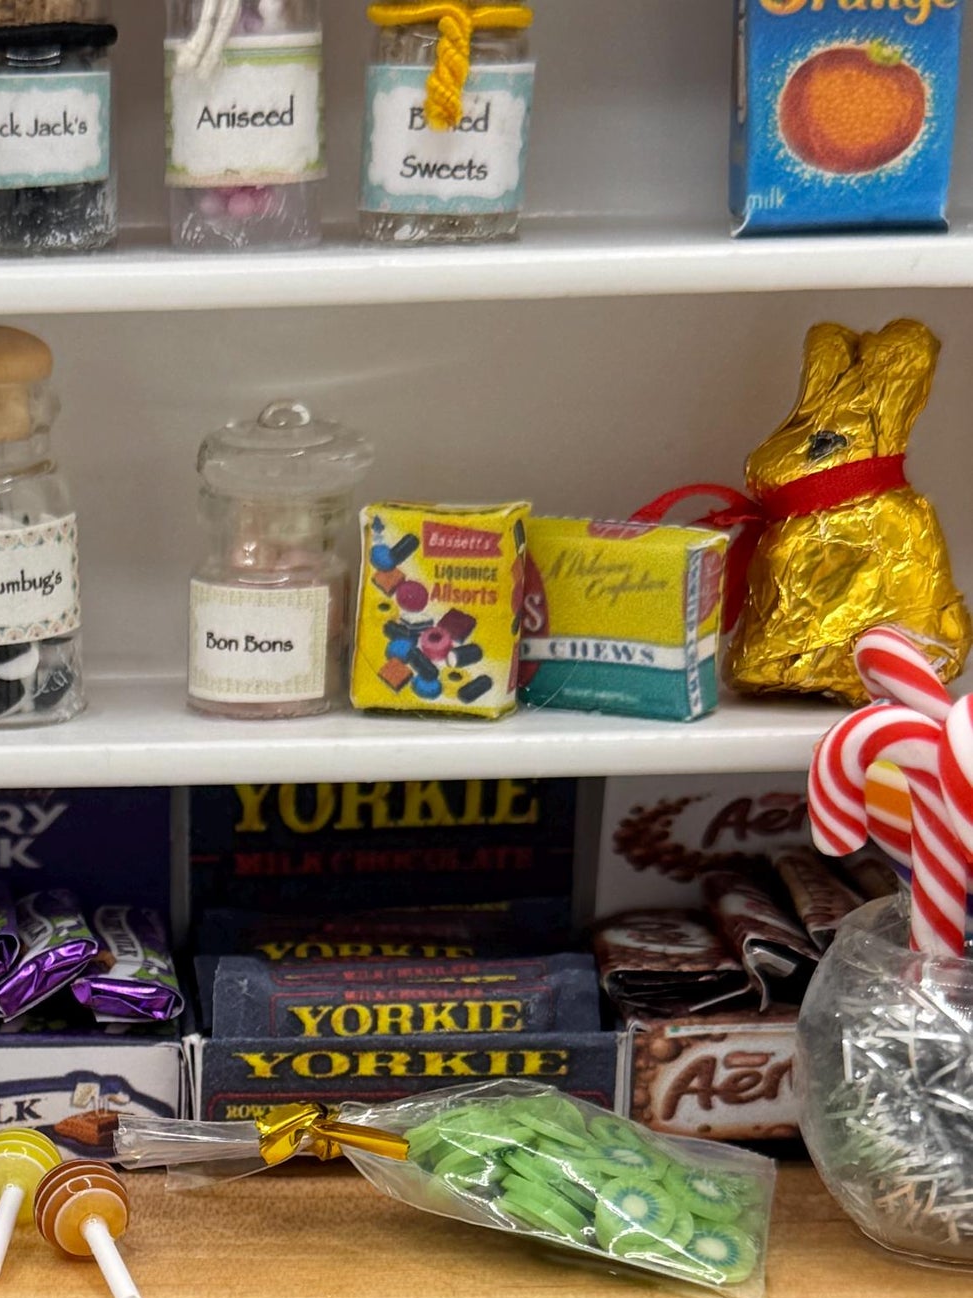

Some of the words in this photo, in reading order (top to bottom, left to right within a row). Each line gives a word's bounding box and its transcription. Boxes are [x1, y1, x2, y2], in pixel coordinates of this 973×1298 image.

[25, 109, 88, 138] Jack's
[197, 96, 294, 130] Aniseed
[408, 101, 491, 133] Bed
[399, 154, 489, 181] Sweets
[430, 582, 498, 606] Allsorts
[205, 631, 239, 651] Bon
[243, 634, 294, 652] Bons
[701, 792, 808, 849] Aer
[287, 1000, 525, 1038] YORKIE
[233, 1050, 569, 1080] YORKIE
[659, 1051, 797, 1122] Aer
